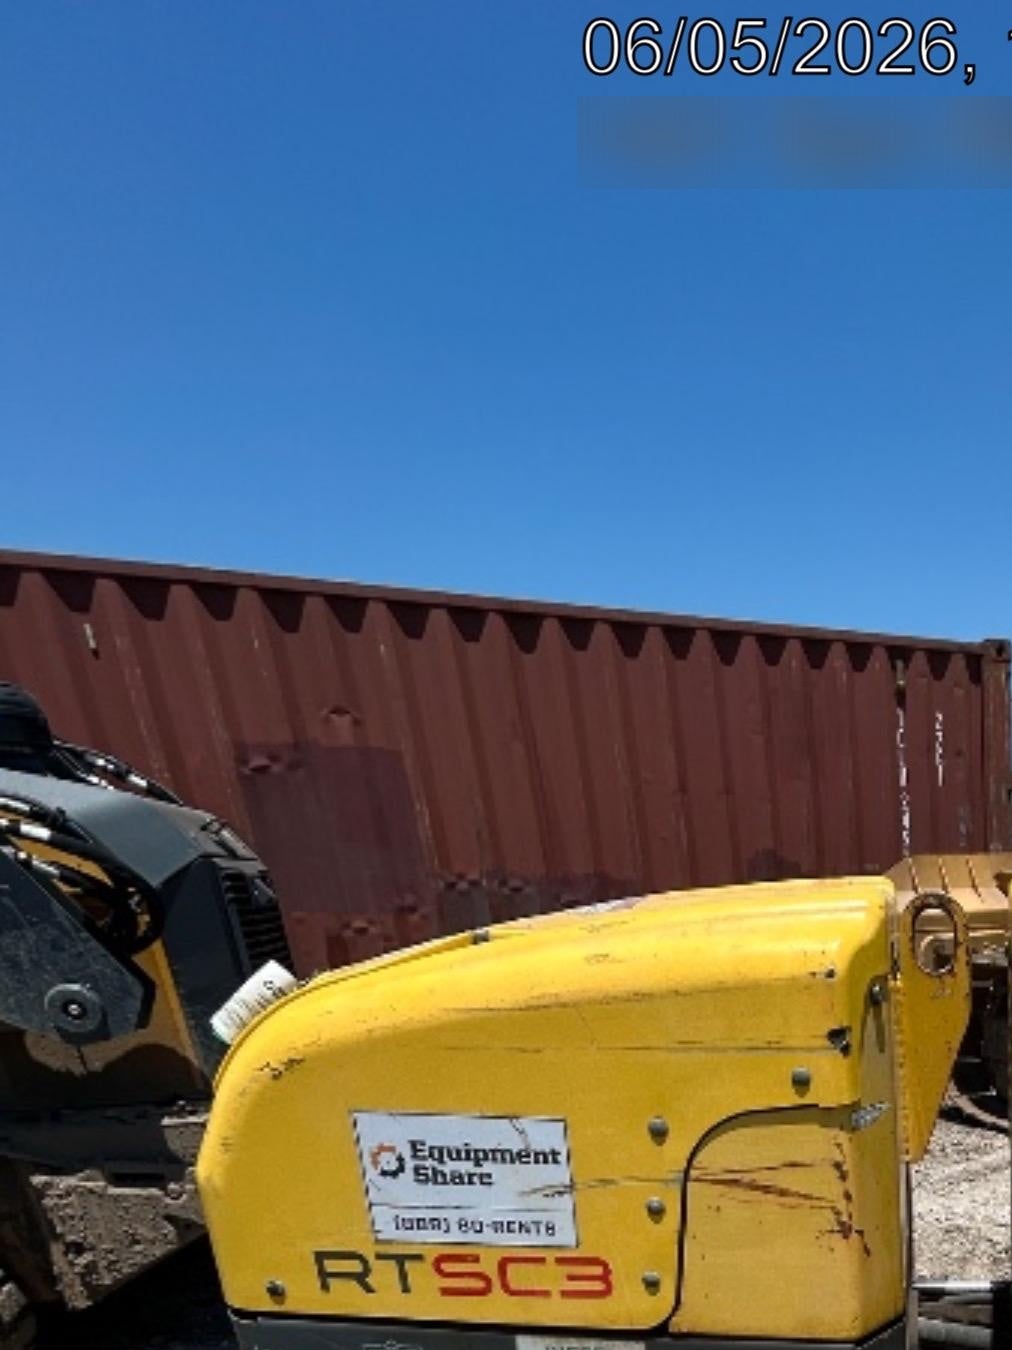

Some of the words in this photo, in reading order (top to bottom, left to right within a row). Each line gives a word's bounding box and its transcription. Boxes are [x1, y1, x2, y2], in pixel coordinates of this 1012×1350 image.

[408, 1139, 562, 1168] Equipment
[413, 1163, 495, 1186] Share
[314, 1251, 613, 1299] RTSC3
